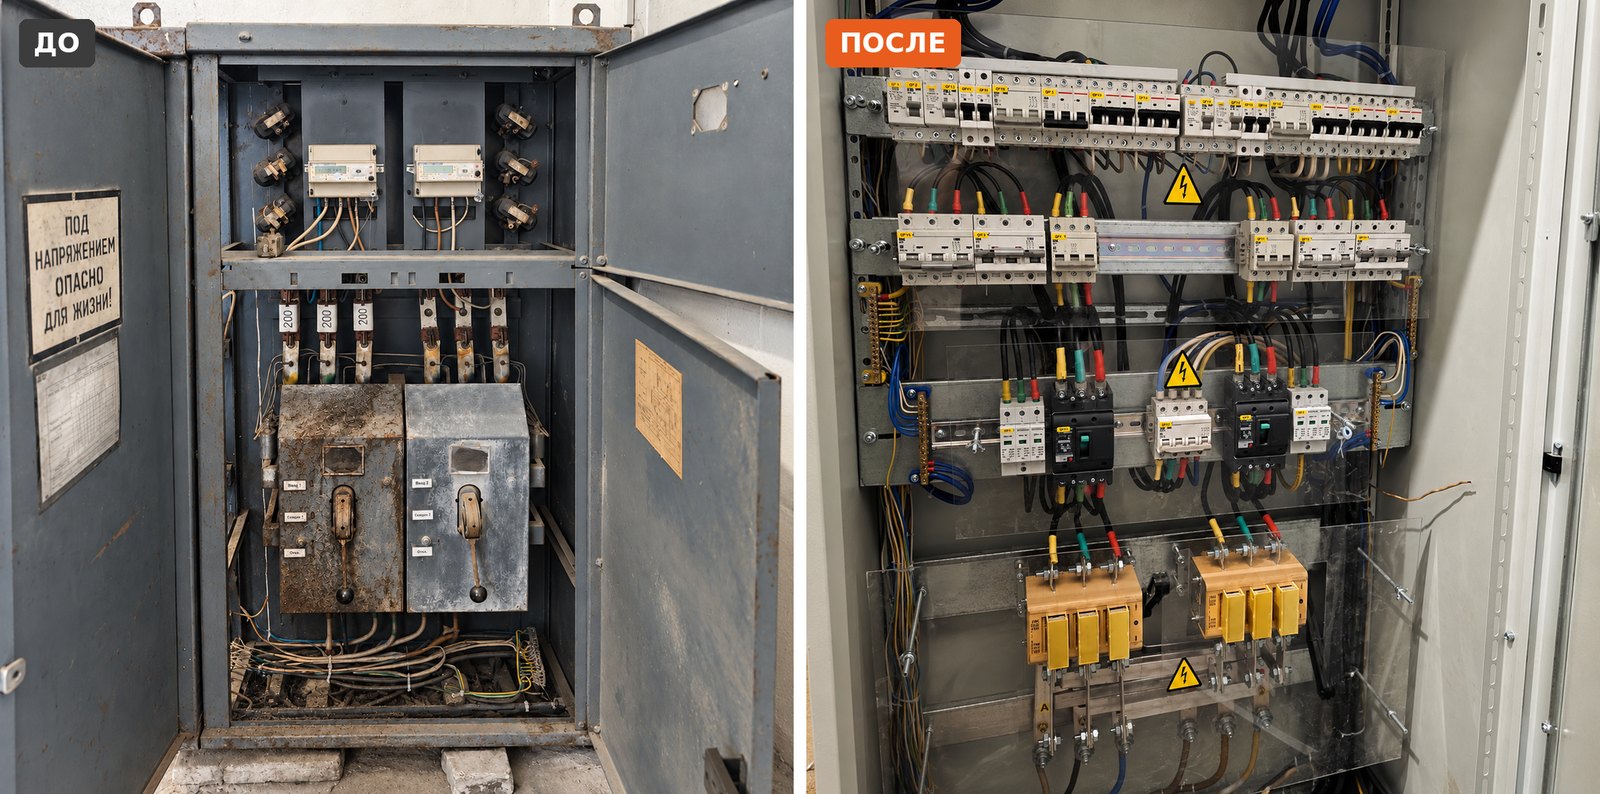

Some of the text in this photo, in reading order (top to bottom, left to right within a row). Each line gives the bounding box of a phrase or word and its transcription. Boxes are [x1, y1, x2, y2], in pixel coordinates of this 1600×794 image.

[64, 214, 90, 236] ПОД
[34, 236, 116, 271] НАПРЯЖЕНИЕМ
[55, 266, 104, 297] ОПАСНО
[44, 287, 112, 334] ДЛЯ ЖИЗНИ!
[283, 309, 293, 328] 200
[321, 309, 332, 329] 200
[358, 308, 368, 326] 200
